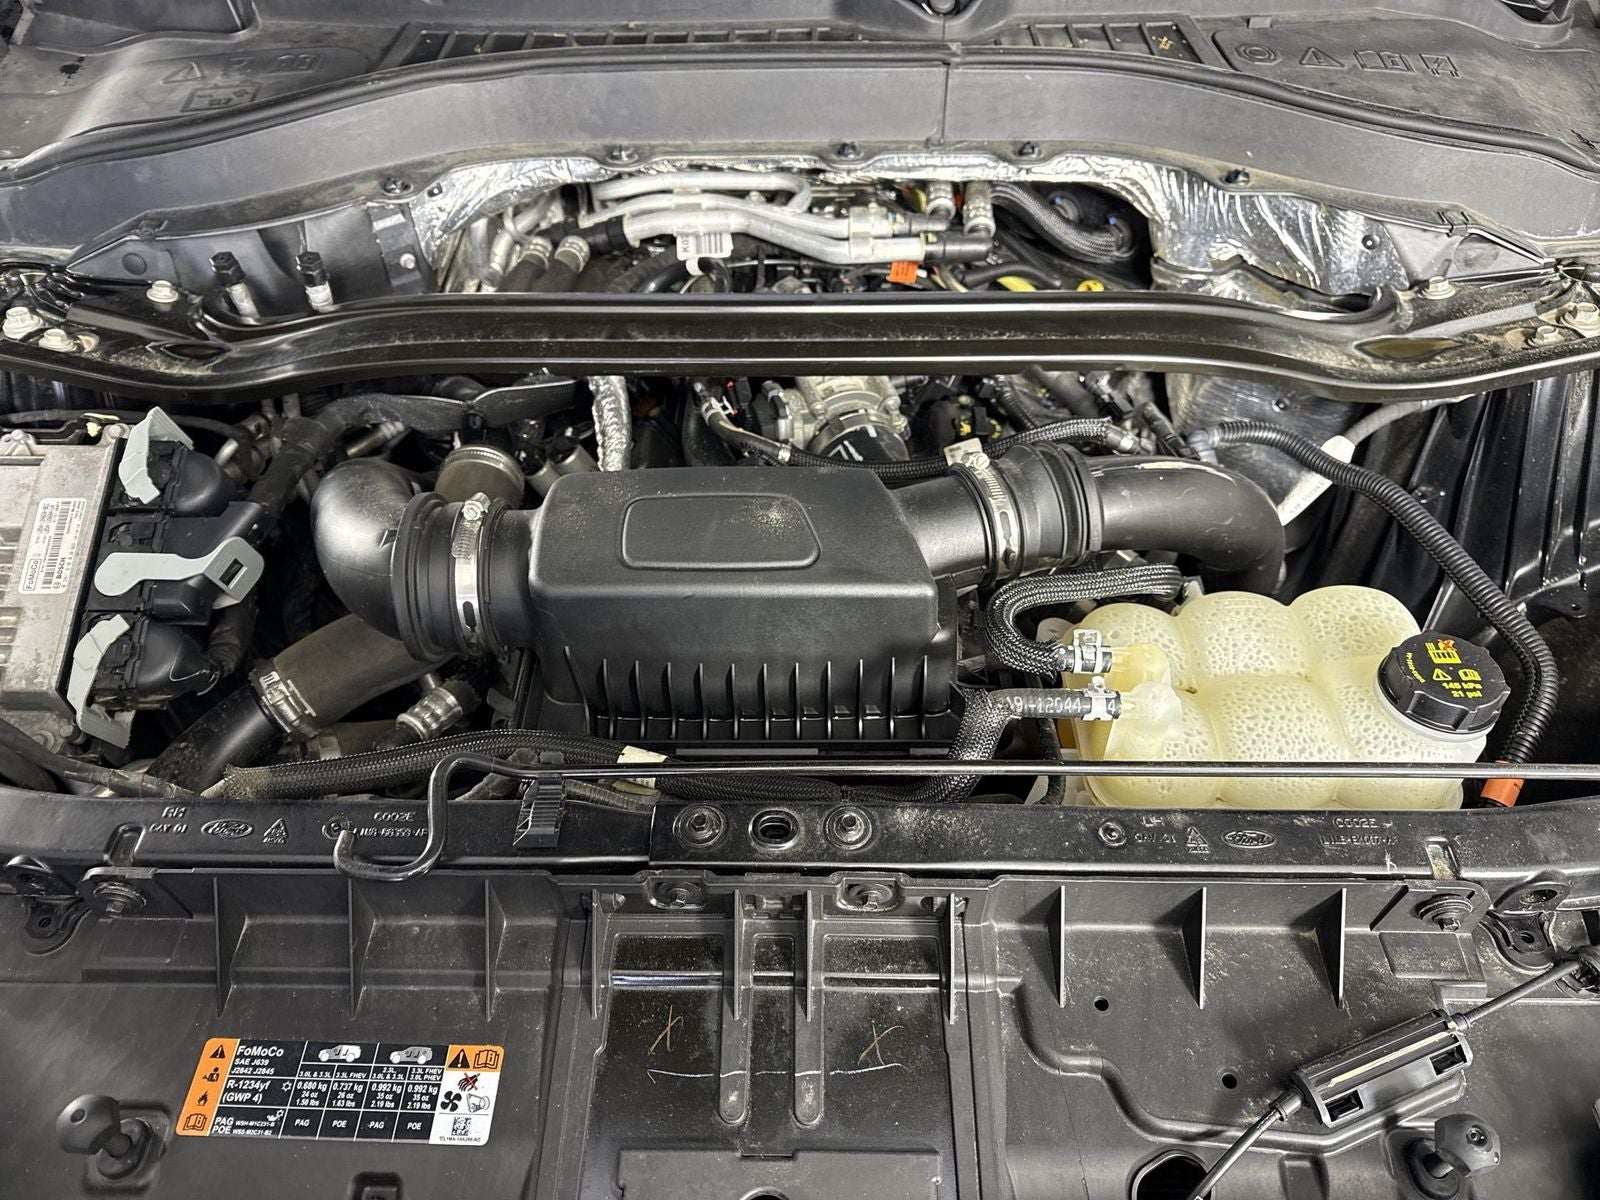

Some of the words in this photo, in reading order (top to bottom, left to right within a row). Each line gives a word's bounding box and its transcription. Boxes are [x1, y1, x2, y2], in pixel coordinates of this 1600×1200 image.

[56, 557, 66, 579] BOSCH
[26, 561, 39, 590] FoMoCo
[1223, 831, 1274, 847] Ford
[236, 1046, 284, 1057] FoMoCo
[226, 1080, 271, 1091] R-1234yf
[296, 1081, 316, 1090] 0.680
[317, 1082, 327, 1092] kg
[332, 1082, 352, 1090] 0.737
[353, 1083, 363, 1093] kg
[371, 1083, 391, 1092] 0.992
[392, 1084, 402, 1094] kg
[407, 1084, 427, 1093] 0.992
[428, 1085, 438, 1095] kg
[222, 1092, 251, 1103] (GWP
[252, 1093, 263, 1104] 4)
[214, 1117, 234, 1126] PAG
[212, 1126, 231, 1135] POE
